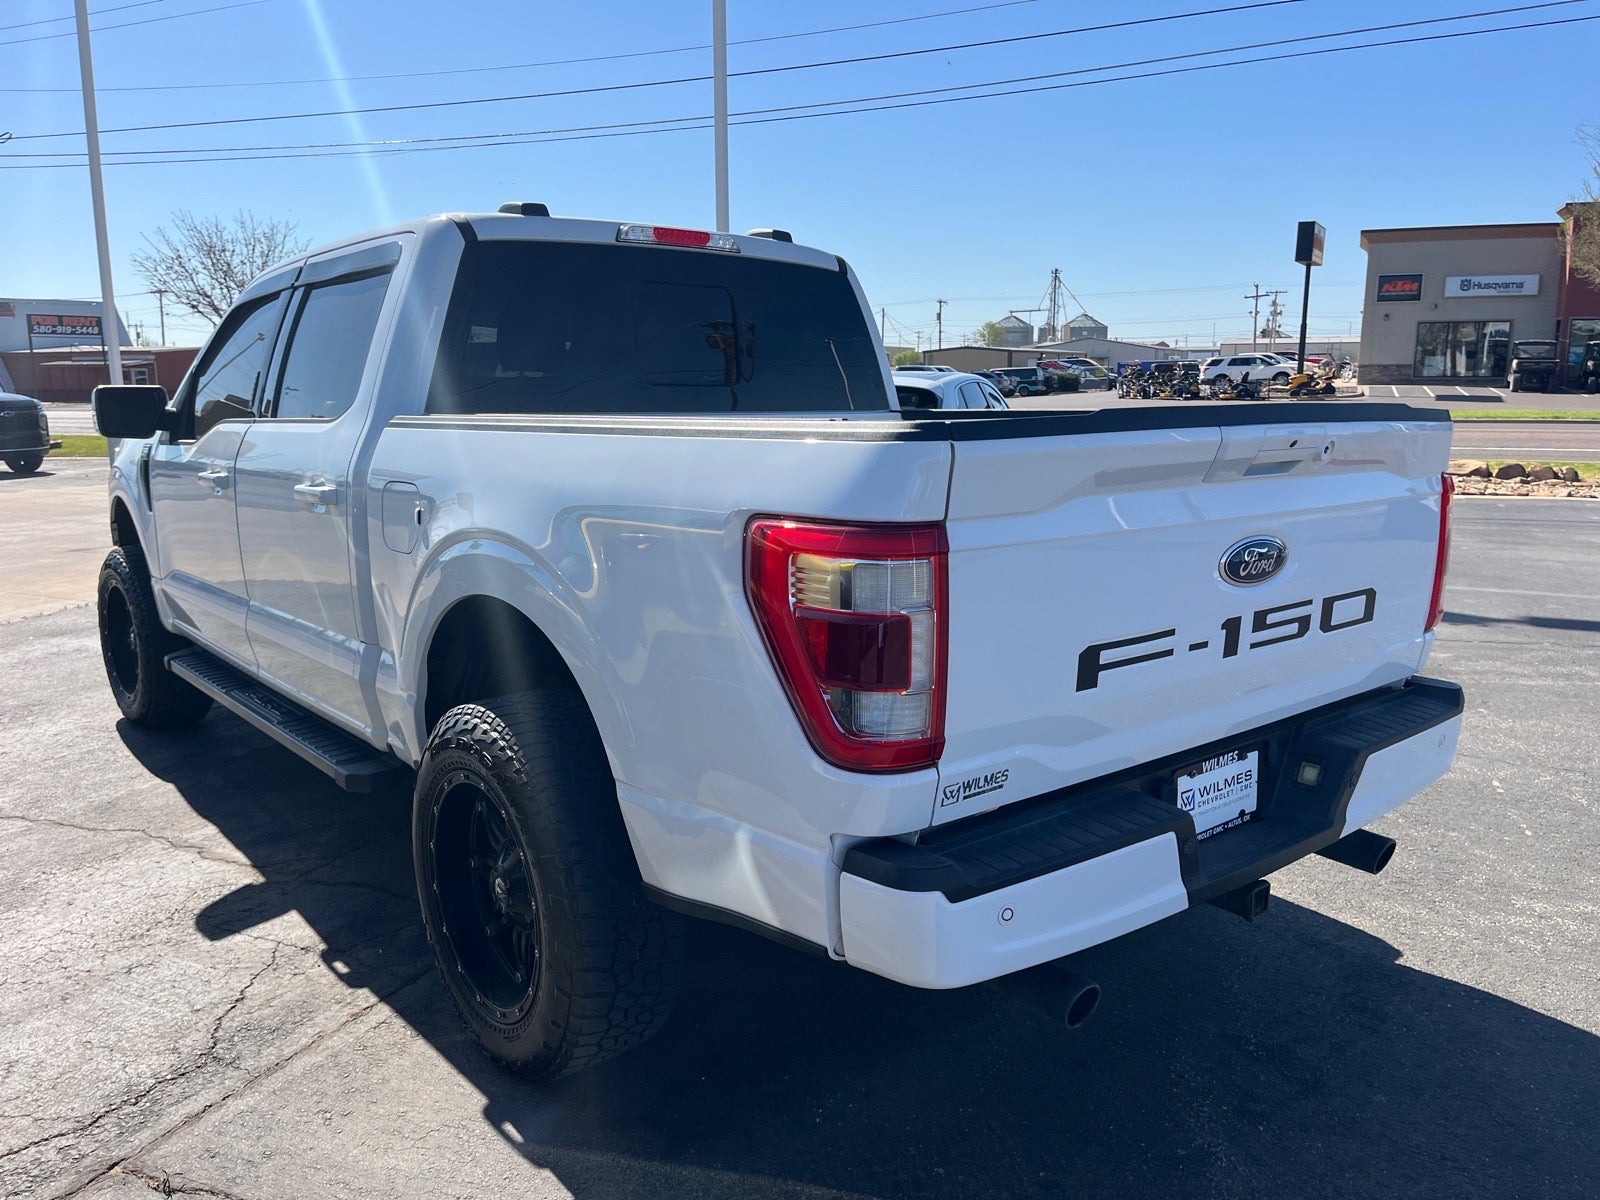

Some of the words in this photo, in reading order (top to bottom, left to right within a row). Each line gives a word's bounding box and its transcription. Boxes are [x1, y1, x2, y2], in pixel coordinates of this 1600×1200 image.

[1472, 281, 1524, 291] Husqvarna
[31, 315, 58, 325] FOR
[62, 317, 98, 327] RENT
[33, 325, 99, 334] 580-919-5448
[1239, 547, 1277, 577] Ford
[1076, 587, 1377, 692] F-150
[1202, 750, 1239, 773] WILMES
[962, 768, 1009, 794] WILMES
[1198, 769, 1253, 798] WILMES
[1198, 789, 1234, 808] CHEVROLET
[1240, 781, 1253, 792] GMC
